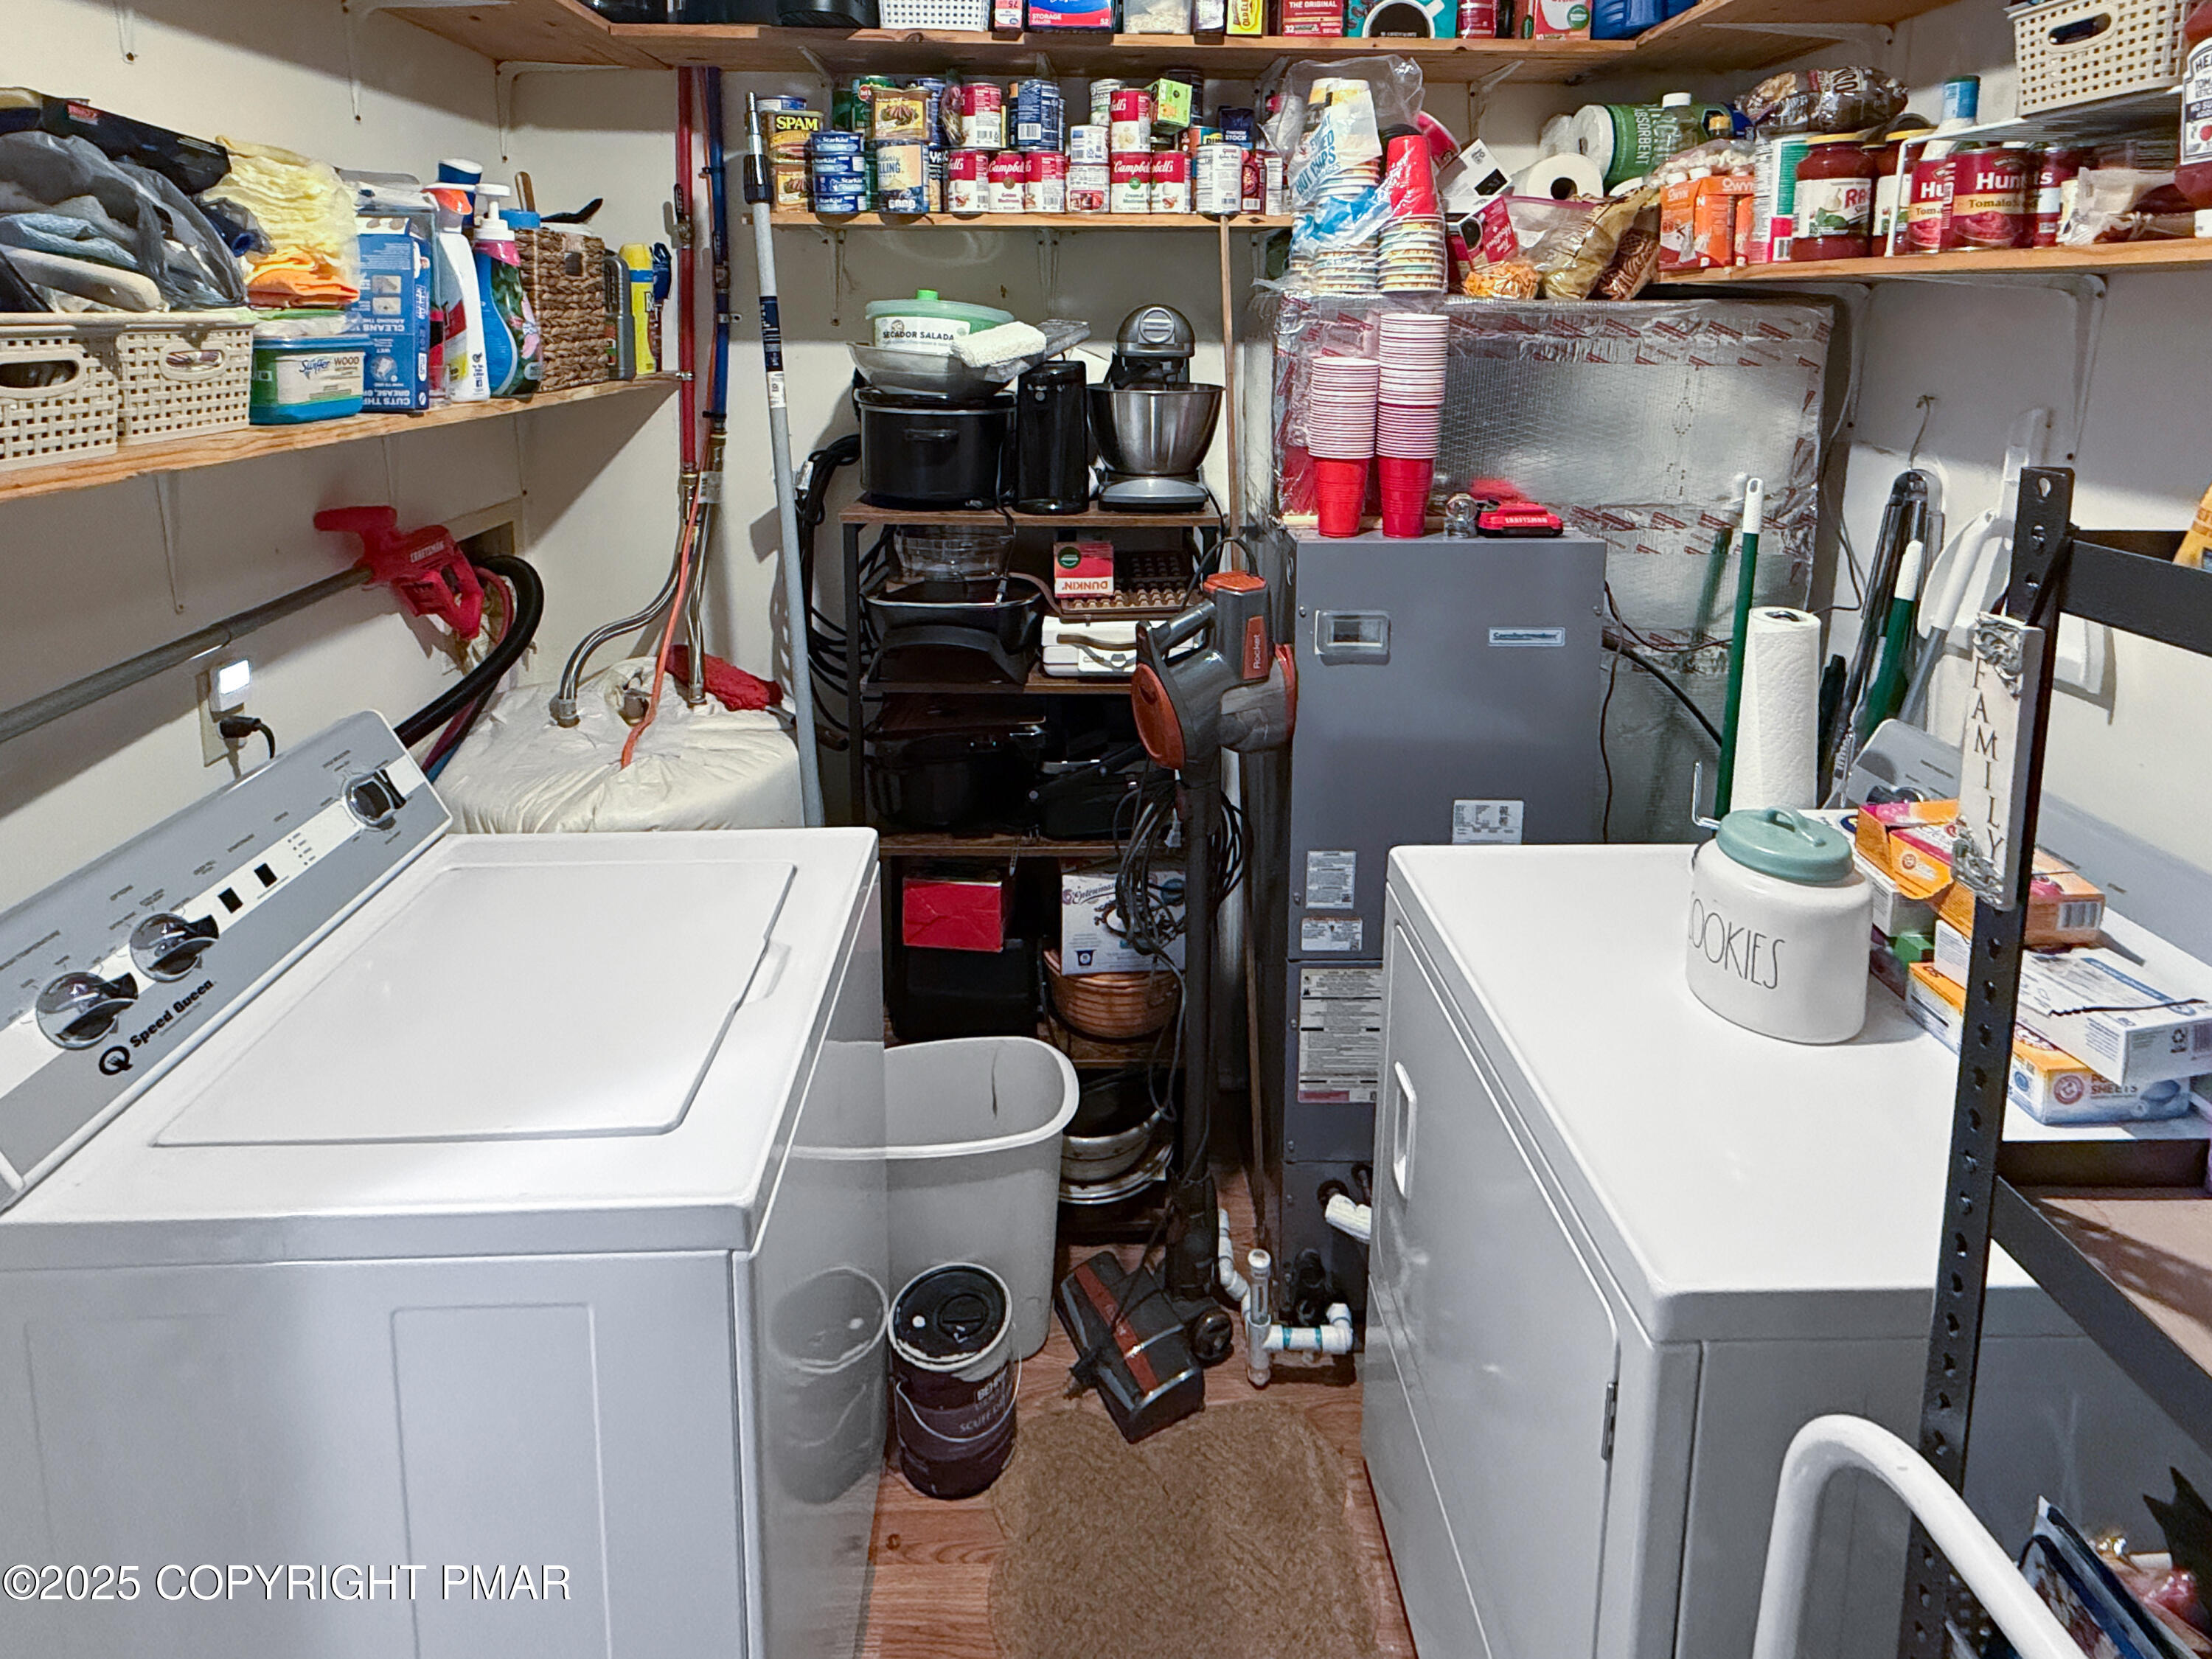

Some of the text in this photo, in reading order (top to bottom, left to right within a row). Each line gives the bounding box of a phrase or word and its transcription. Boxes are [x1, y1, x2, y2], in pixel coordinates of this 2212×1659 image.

[1284, 25, 1295, 33] 32
[776, 116, 819, 131] SPAM
[1633, 108, 1652, 164] ABSORBENT
[819, 197, 843, 205] StarKist
[364, 324, 405, 333] CLEANS
[882, 331, 955, 341] SECADOR SALADA
[299, 356, 361, 375] Swiffer WOOD
[383, 397, 411, 406] CUTS
[1505, 516, 1548, 524] CRAFTSMAN
[410, 541, 445, 563] CRAFTSMAN
[1253, 634, 1262, 669] Rocket
[1971, 655, 2006, 860] FAMILY
[130, 979, 215, 1048] Speed Queen
